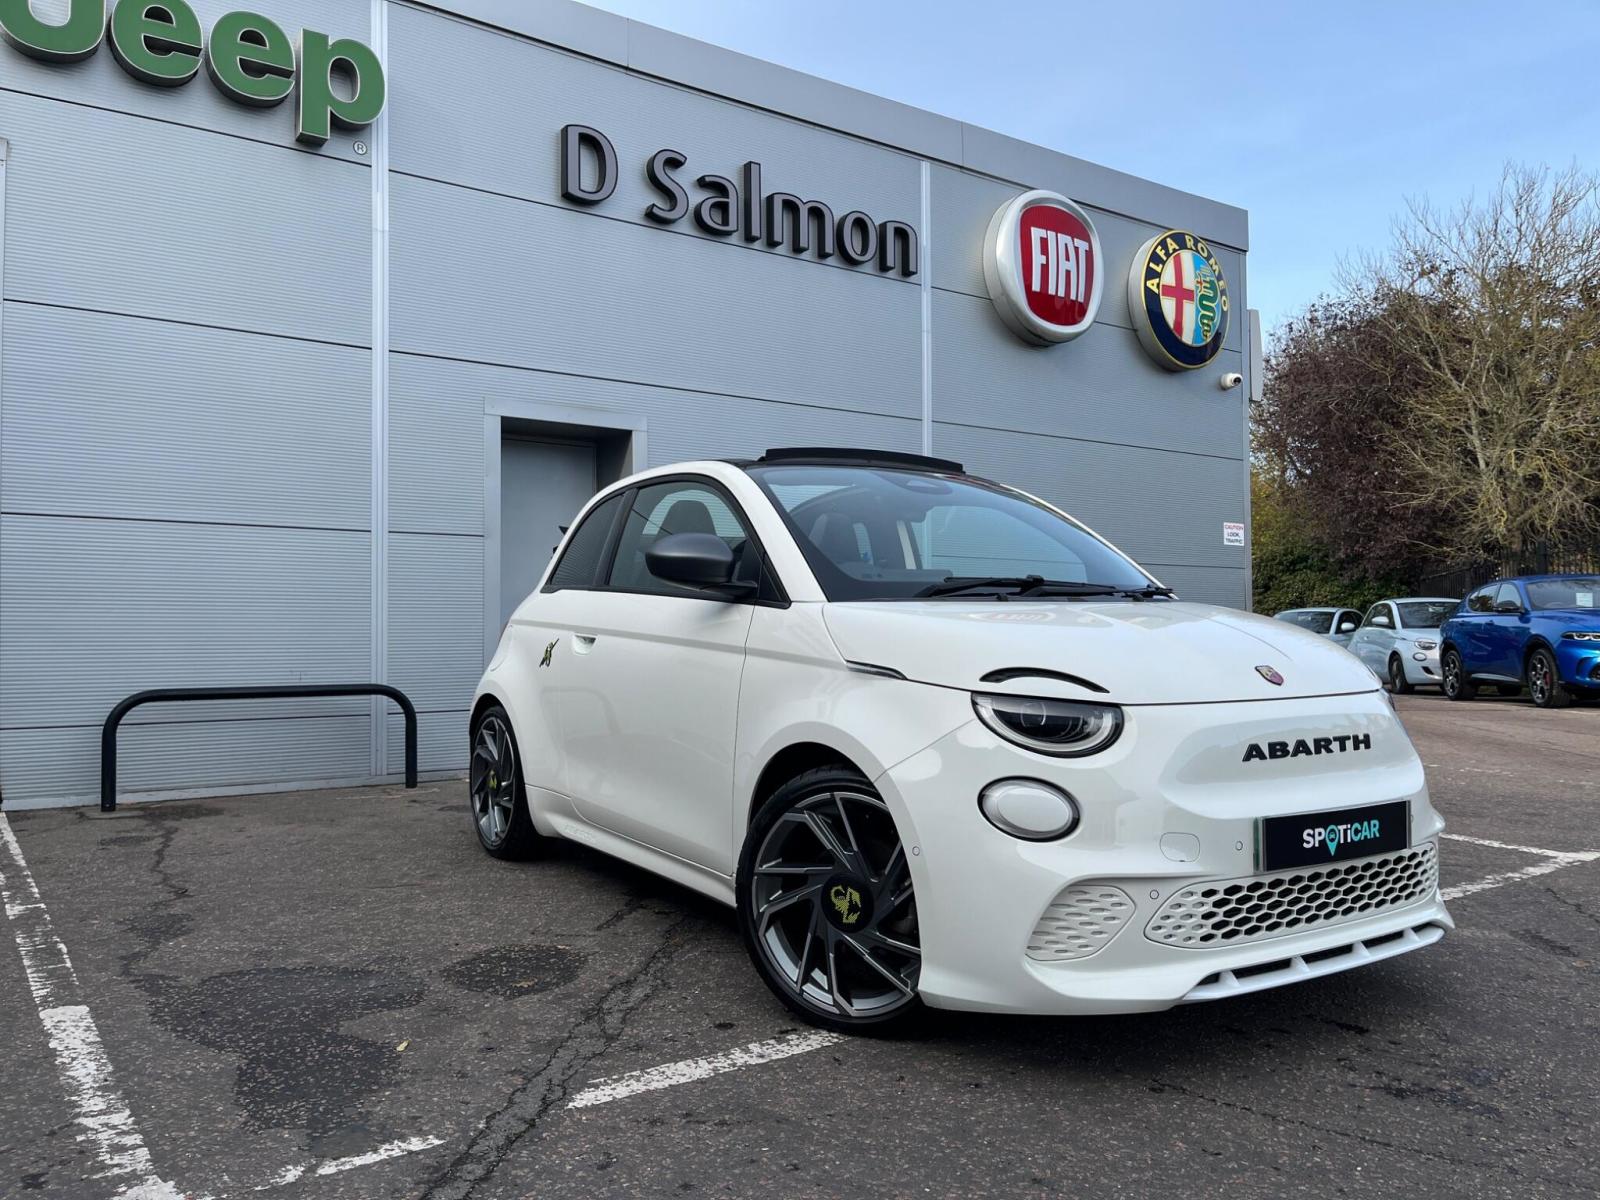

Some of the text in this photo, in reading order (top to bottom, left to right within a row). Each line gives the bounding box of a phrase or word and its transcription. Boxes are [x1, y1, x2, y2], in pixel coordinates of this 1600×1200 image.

[561, 124, 918, 277] D Salmon
[1030, 226, 1089, 303] FIAT
[1146, 234, 1228, 312] ALFA ROMEO
[1242, 733, 1371, 762] ABARTH
